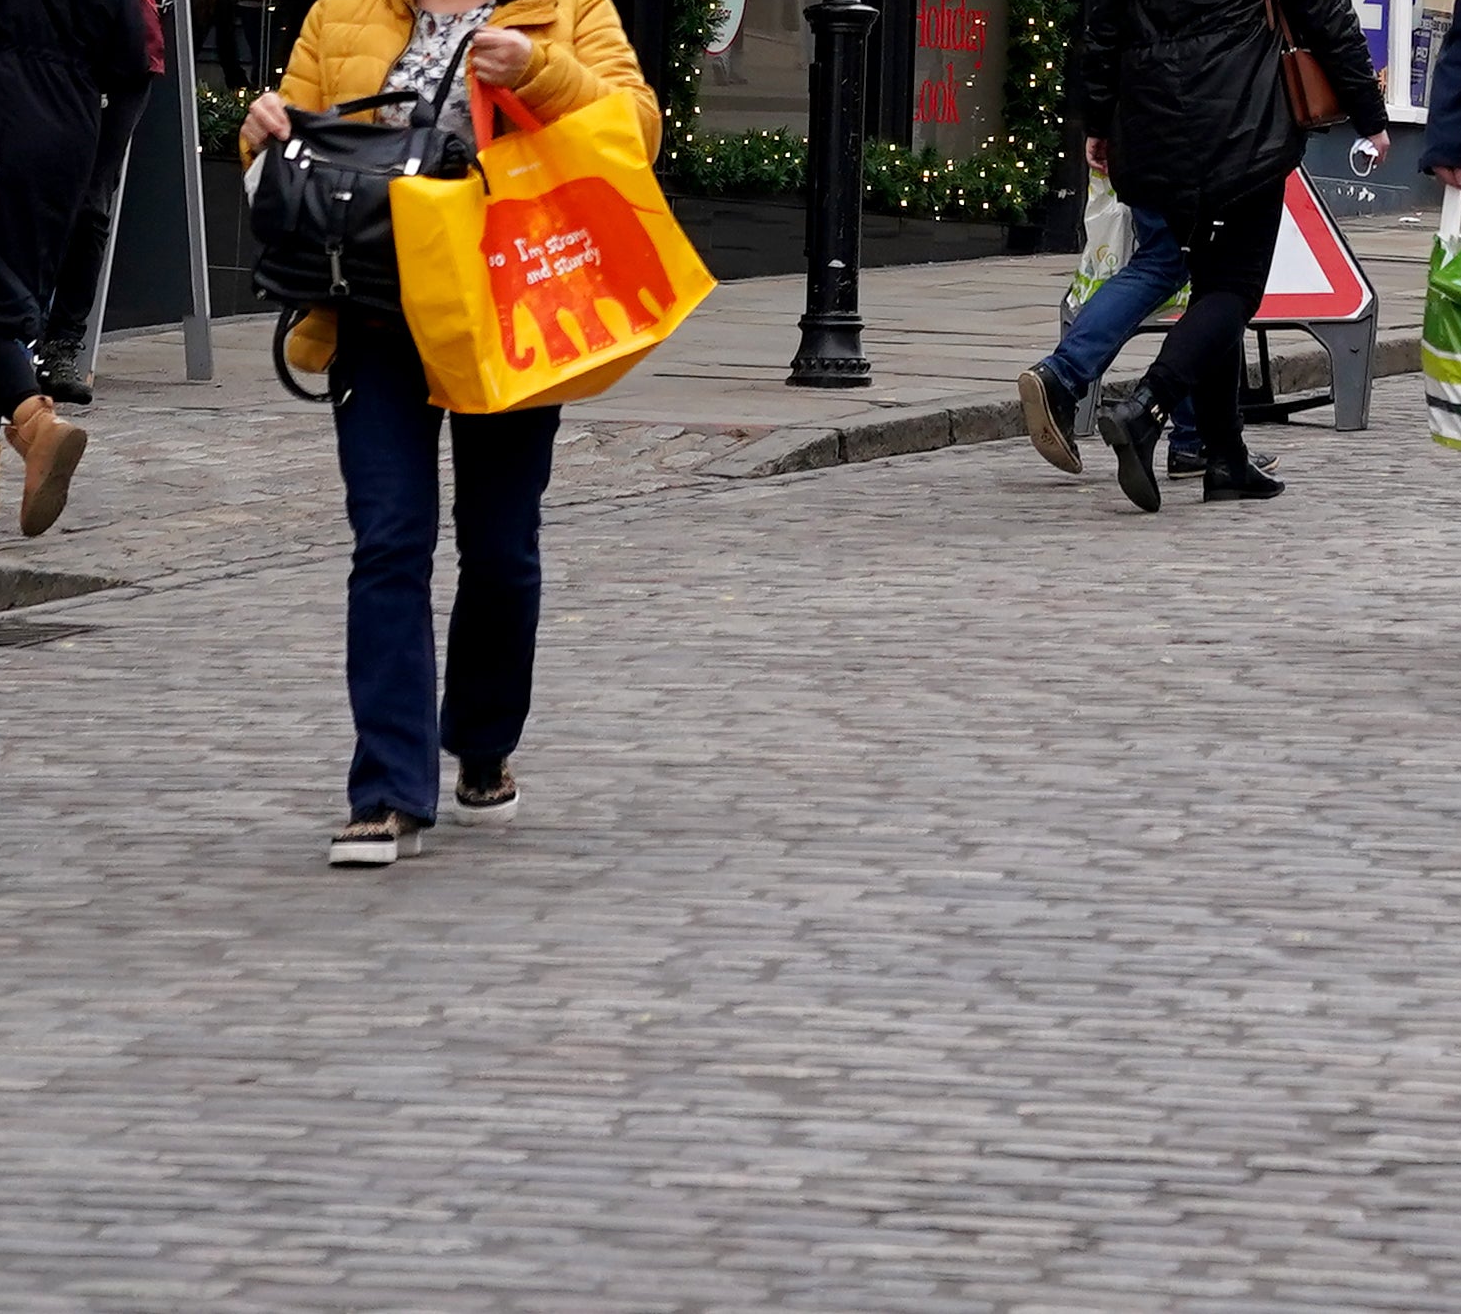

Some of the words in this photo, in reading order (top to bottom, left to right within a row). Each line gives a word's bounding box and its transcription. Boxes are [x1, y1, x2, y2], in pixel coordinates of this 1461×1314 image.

[514, 237, 545, 263] I'm
[545, 227, 593, 255] strong
[526, 256, 553, 285] and
[553, 246, 601, 277] sturdy
